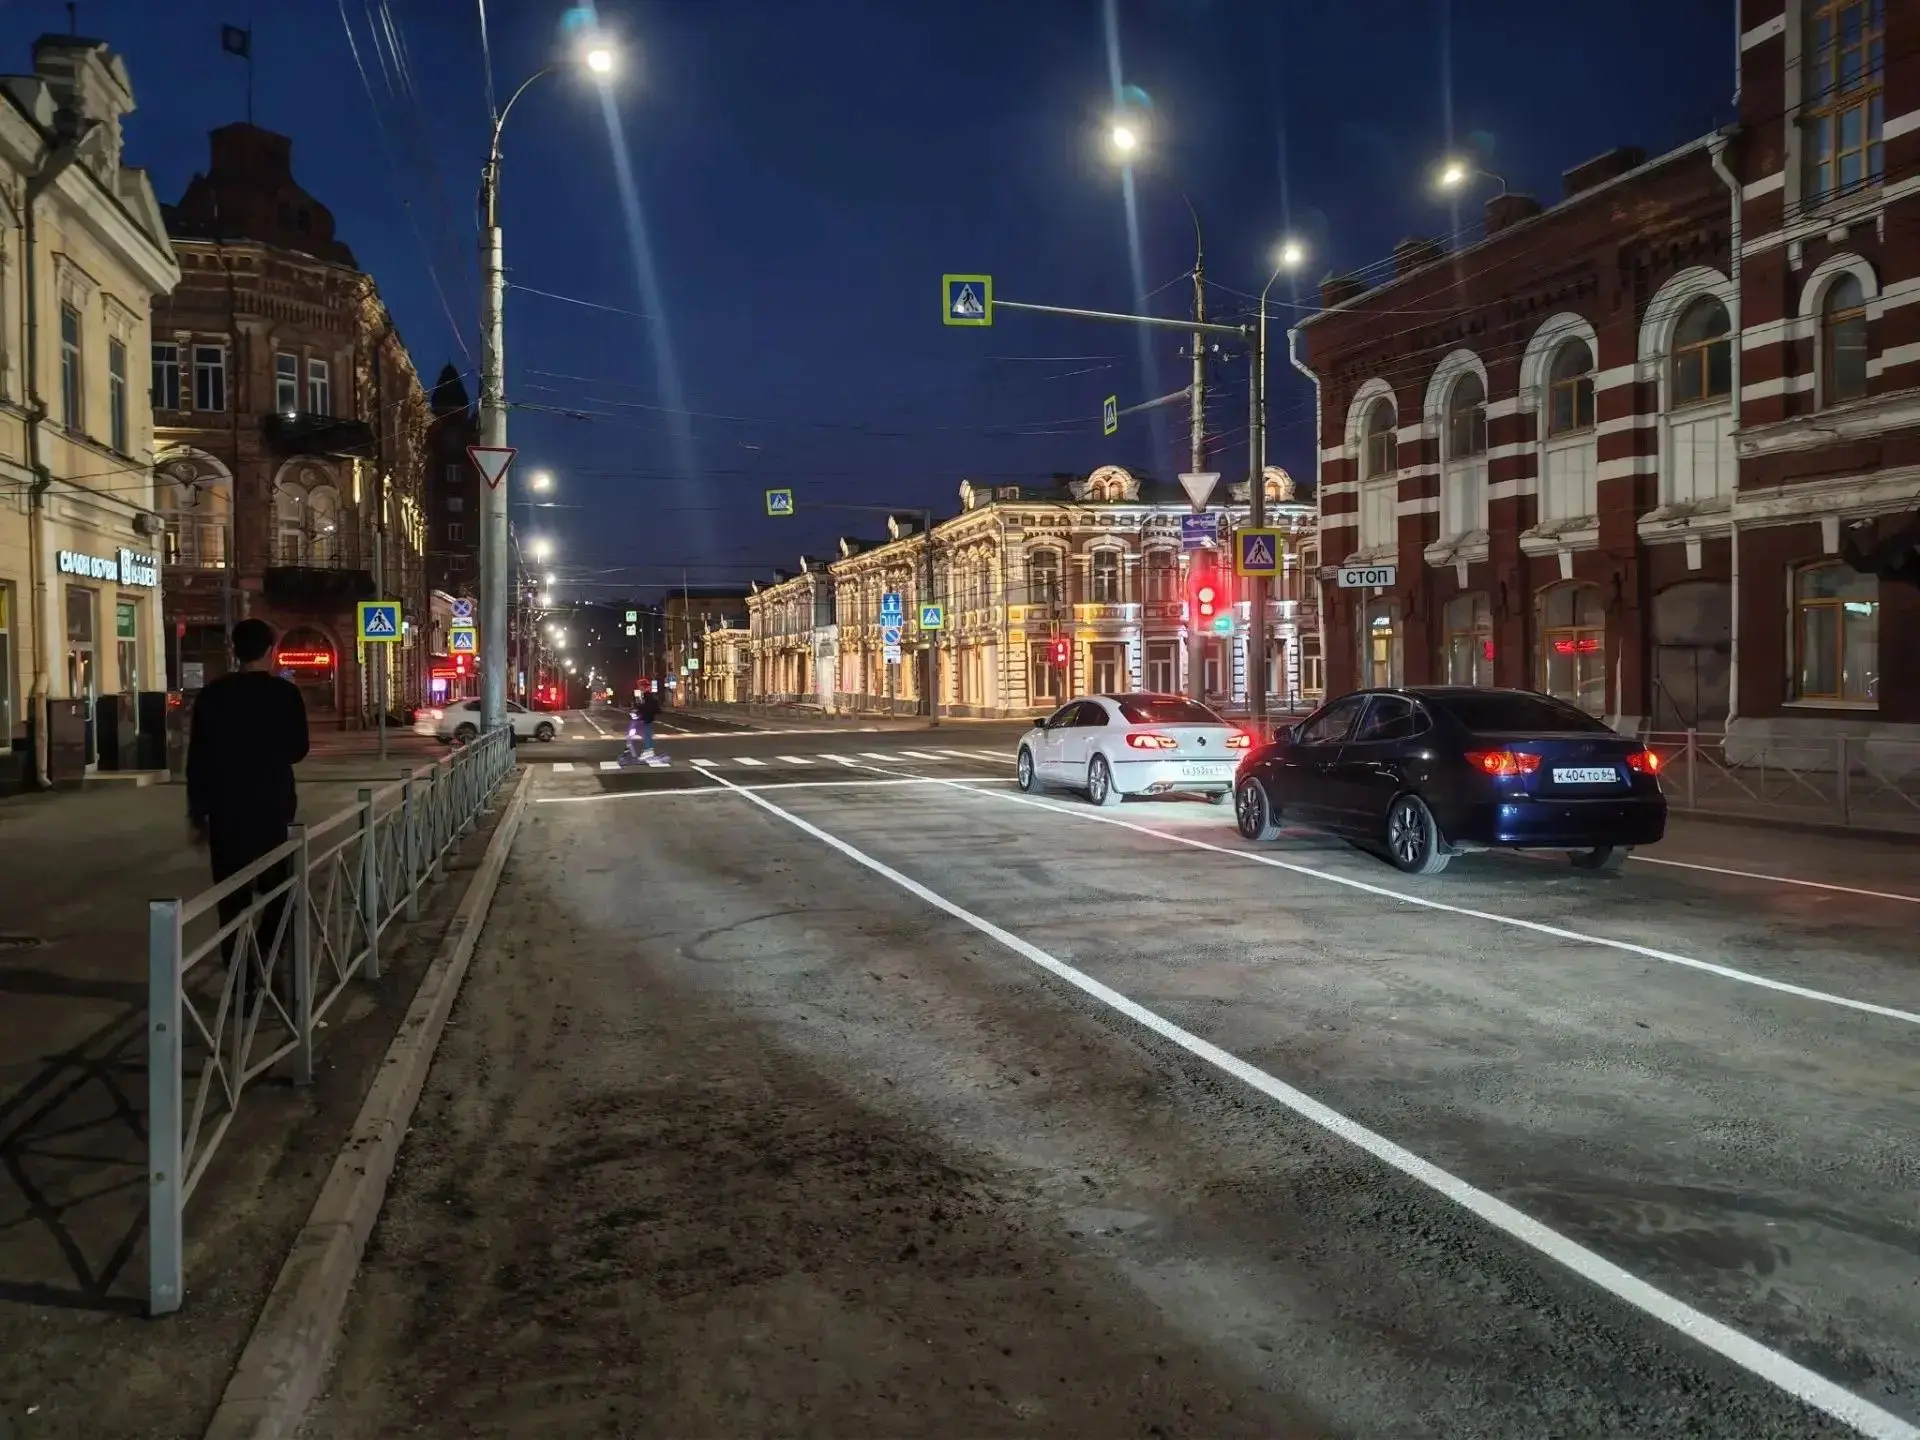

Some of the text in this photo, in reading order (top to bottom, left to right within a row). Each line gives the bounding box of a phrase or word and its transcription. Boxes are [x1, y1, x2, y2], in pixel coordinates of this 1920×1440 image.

[60, 550, 91, 577] САЛОН
[91, 557, 118, 581] ОБУВИ
[1346, 570, 1388, 584] СТОП
